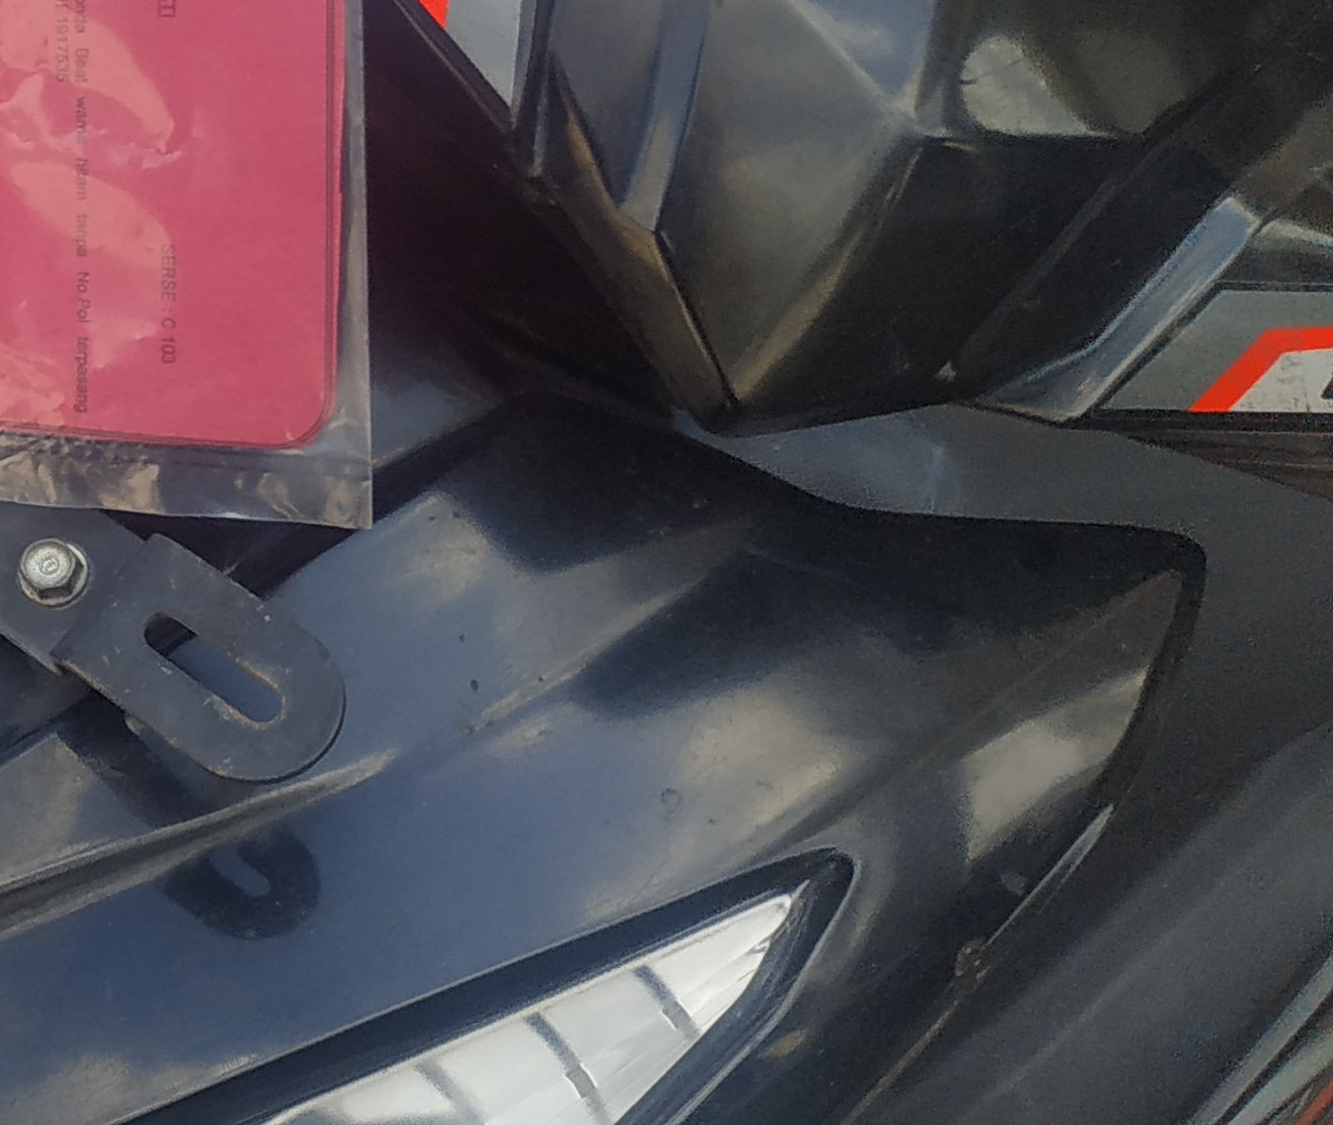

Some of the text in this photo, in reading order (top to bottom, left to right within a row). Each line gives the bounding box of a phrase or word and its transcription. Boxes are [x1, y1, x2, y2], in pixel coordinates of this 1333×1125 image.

[159, 242, 176, 304] SERSE
[159, 317, 176, 331] C
[159, 335, 176, 365] 103
[71, 335, 89, 414] terpasang
